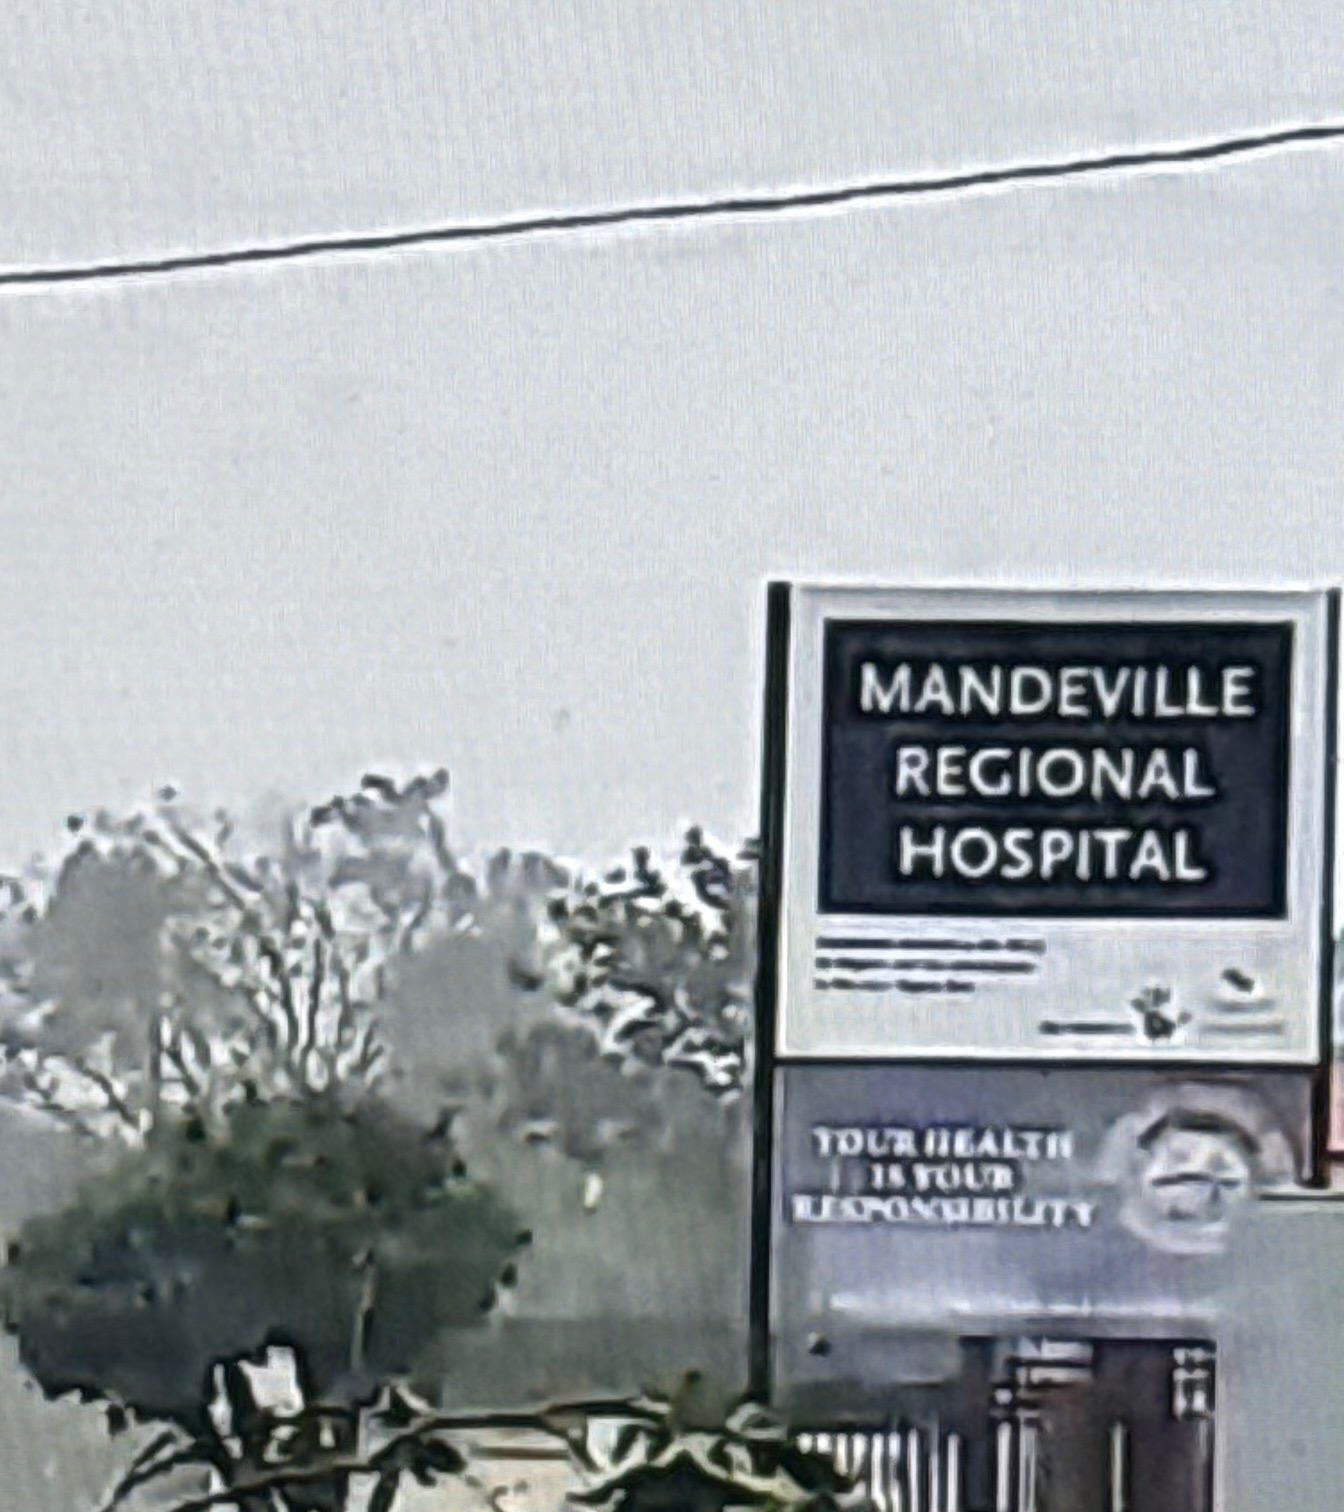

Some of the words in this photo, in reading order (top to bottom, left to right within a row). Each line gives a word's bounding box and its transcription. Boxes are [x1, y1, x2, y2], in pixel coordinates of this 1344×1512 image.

[859, 661, 1256, 718] MANDEVILLE
[895, 746, 1216, 801] REGIONAL
[898, 826, 1208, 882] HOSPITAL
[813, 1125, 916, 1158] YOUR
